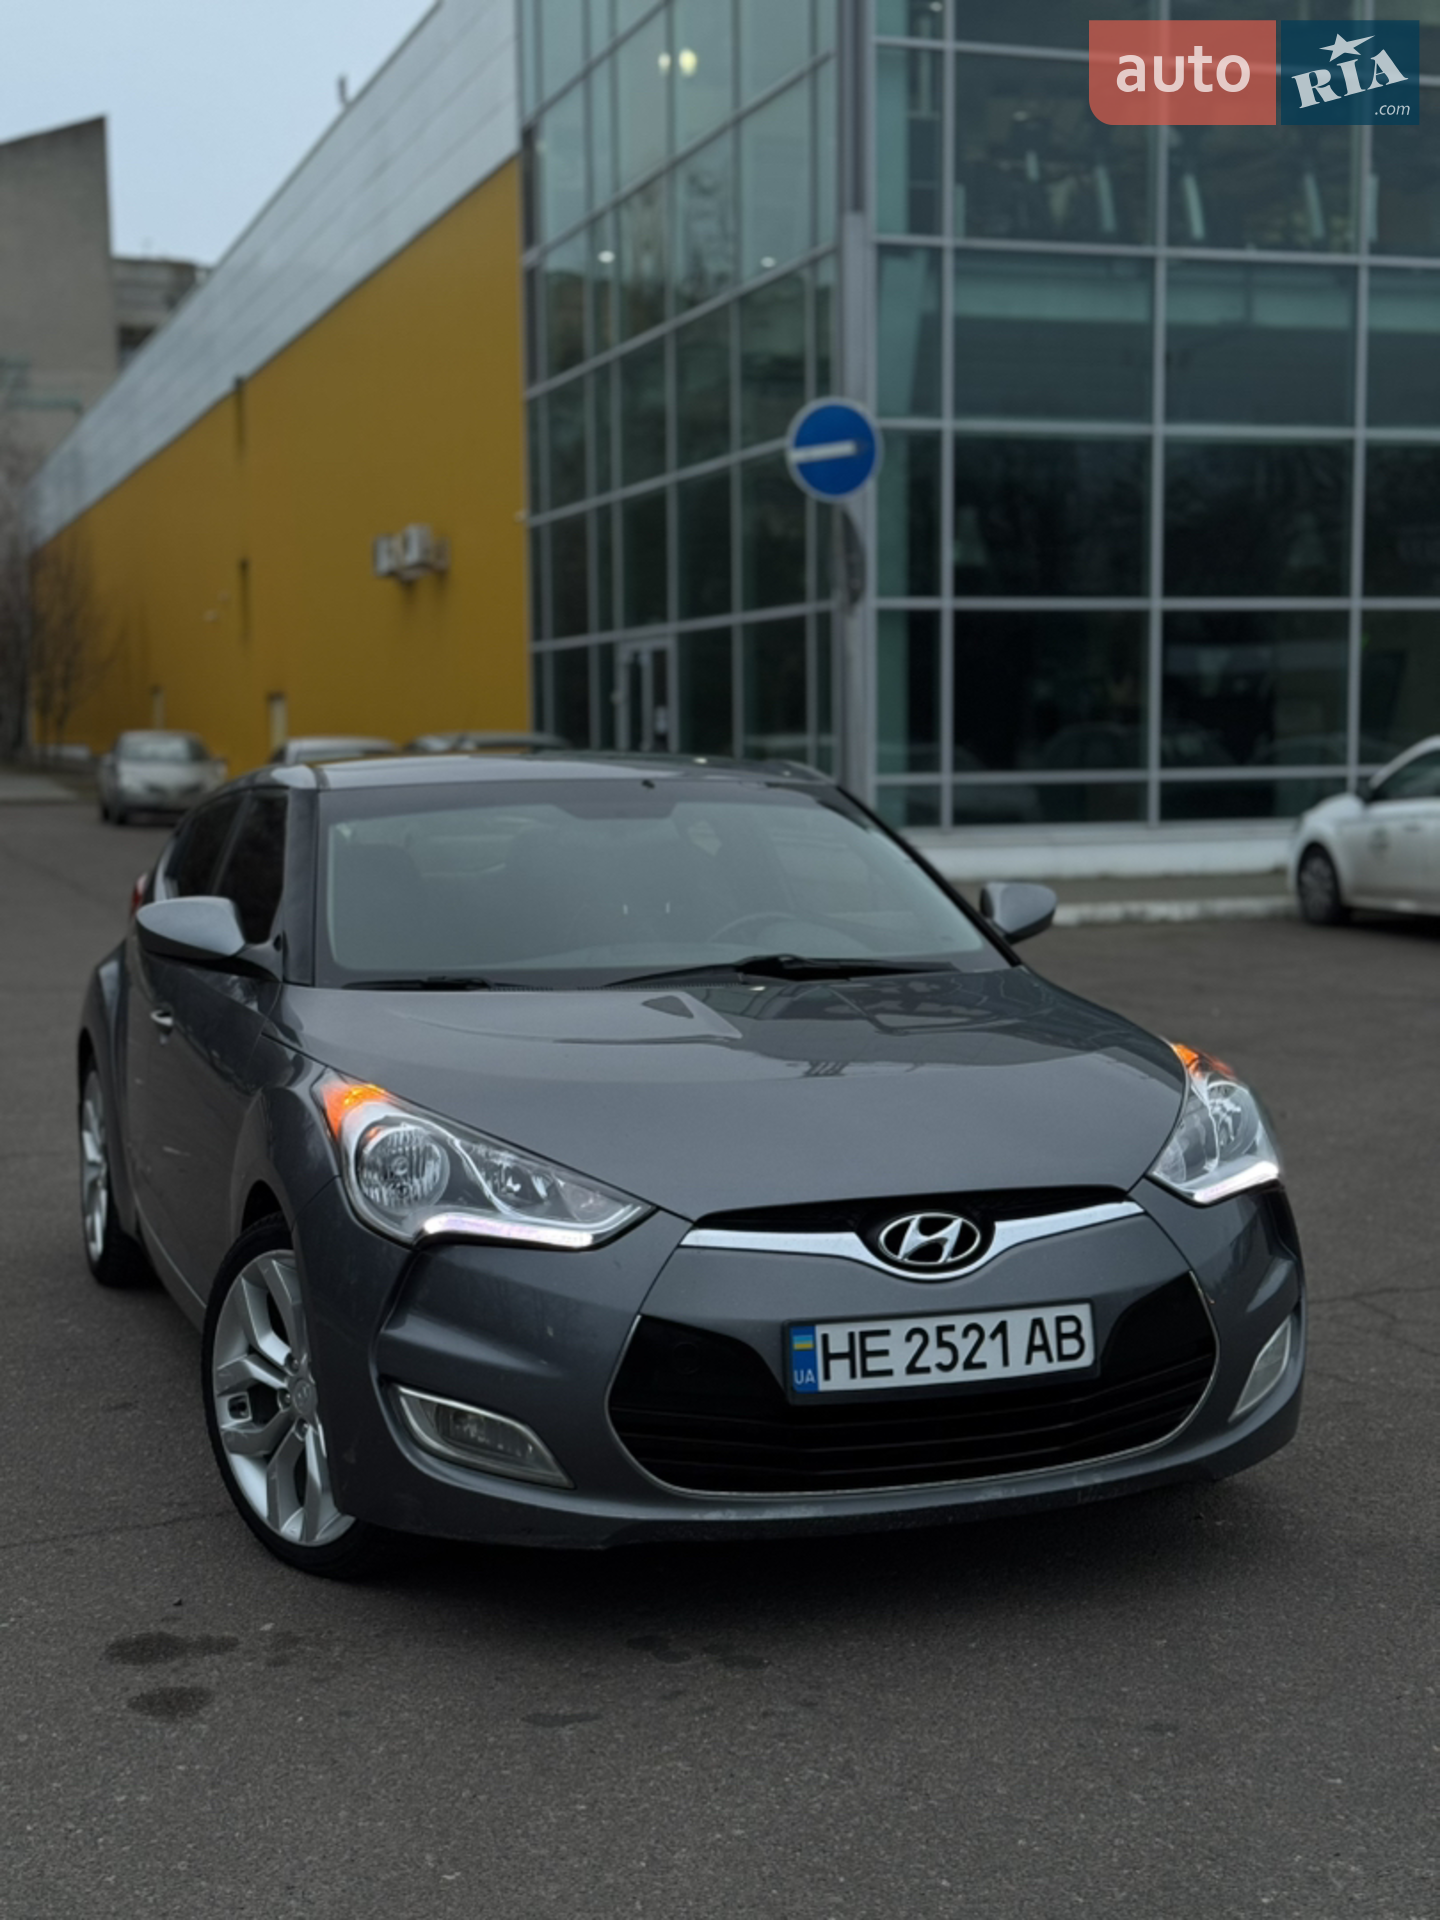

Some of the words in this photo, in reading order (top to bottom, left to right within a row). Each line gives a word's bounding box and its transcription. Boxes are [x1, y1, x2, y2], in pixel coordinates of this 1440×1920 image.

[821, 1329, 894, 1382] HE
[904, 1320, 1009, 1375] 2521
[1025, 1314, 1086, 1366] AB
[793, 1368, 816, 1386] UA
